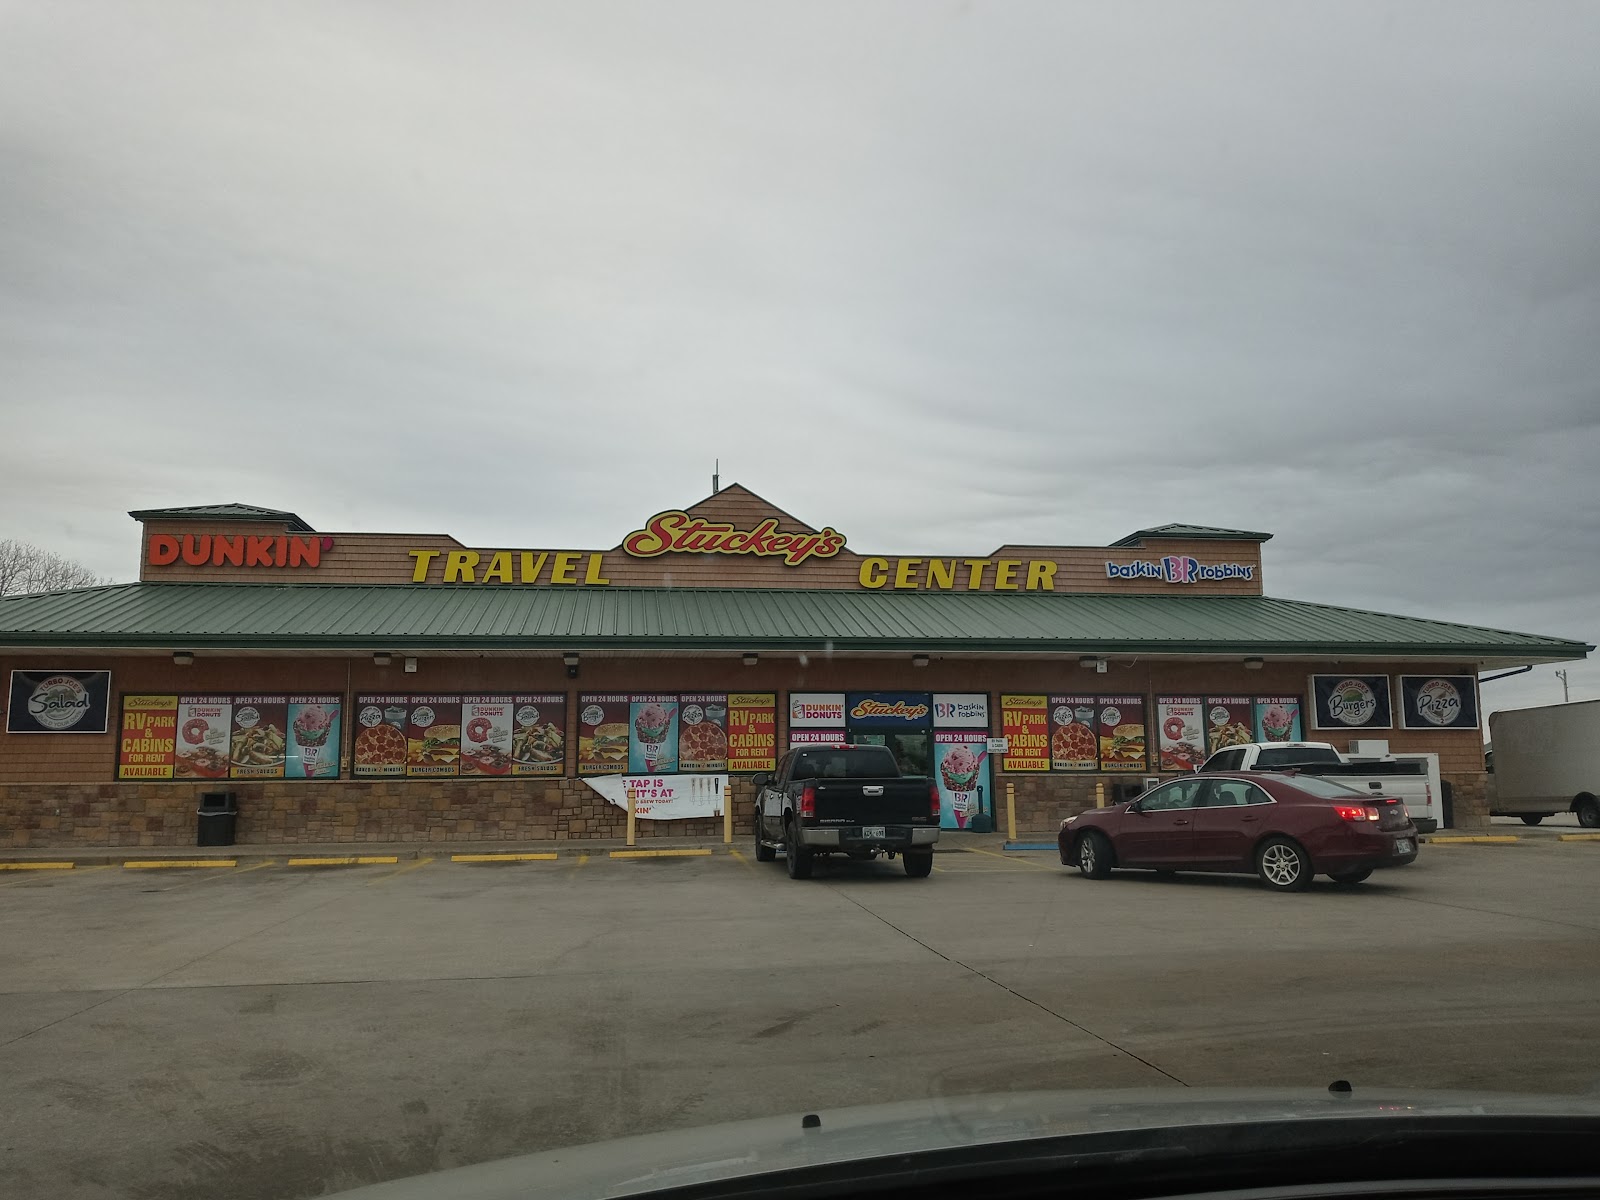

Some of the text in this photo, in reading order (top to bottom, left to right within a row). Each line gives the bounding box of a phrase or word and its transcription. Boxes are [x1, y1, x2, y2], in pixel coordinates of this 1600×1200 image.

[623, 509, 846, 566] Stuckey's
[148, 534, 334, 568] DUNKIN'
[408, 549, 1058, 591] TRAVEL CENTER
[1106, 556, 1254, 584] baskin BR robbins
[40, 678, 82, 694] TURBO JOE'S
[1336, 681, 1354, 694] TURBO
[1422, 681, 1440, 694] TURBO
[30, 692, 89, 714] Salad
[851, 699, 928, 720] Stuckey's
[1329, 694, 1375, 716] Burgers
[1418, 695, 1459, 713] Pizza
[806, 711, 842, 719] DONUTS
[934, 703, 956, 717] BR
[124, 712, 175, 730] RV PARK
[729, 710, 775, 726] RV PARK
[1003, 711, 1047, 727] RV PARK
[144, 728, 153, 738] &
[748, 724, 756, 733] &
[1021, 724, 1030, 734] &
[729, 733, 775, 747] CABINS
[791, 733, 845, 741] OPEN 24 HOURS
[935, 734, 987, 742] OPEN 24 HOURS
[122, 738, 174, 753] CABINS
[128, 754, 166, 763] FOR RENT
[735, 748, 769, 757] FOR RENT
[1010, 748, 1042, 757] FOR RENT
[732, 760, 771, 769] AVALIABLE
[1007, 760, 1045, 769] AVALIABLE
[123, 767, 168, 776] AVALIABLE
[629, 779, 651, 788] TAP
[653, 779, 664, 788] IS
[636, 789, 658, 798] IT'S
[660, 789, 674, 798] AT
